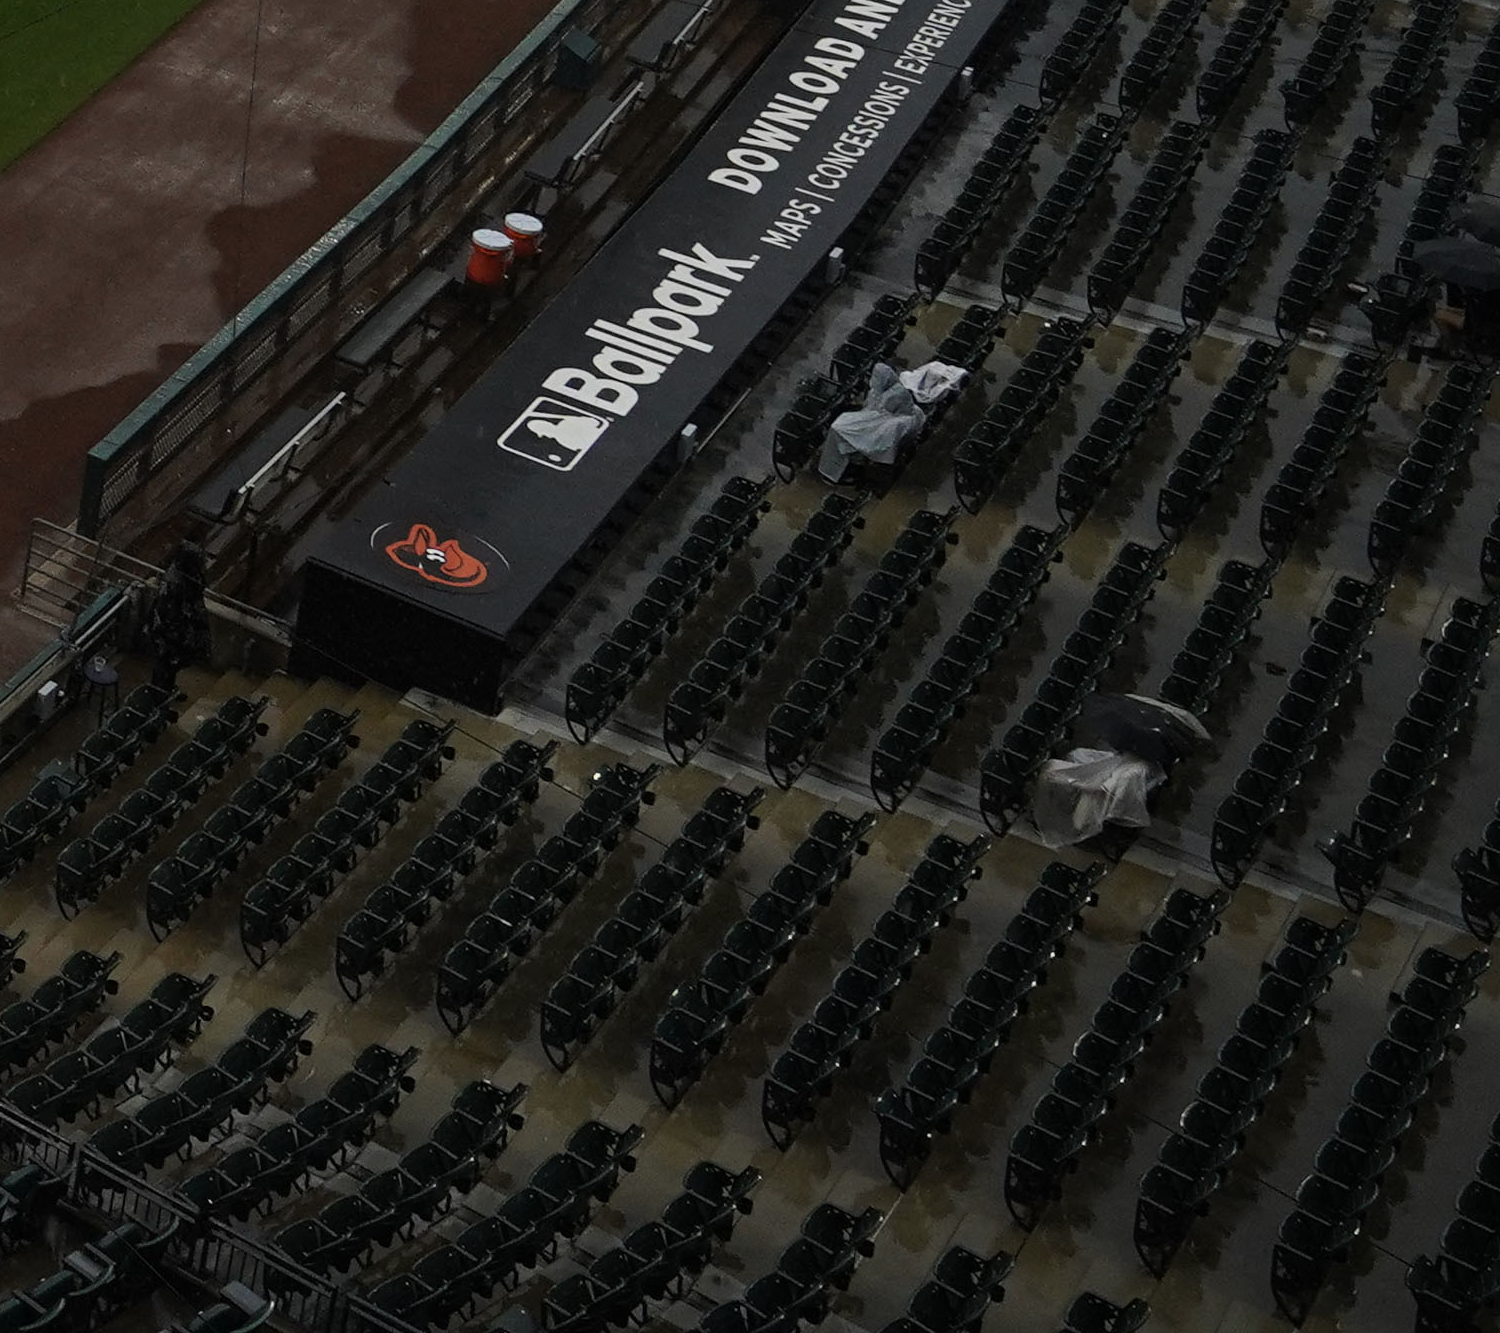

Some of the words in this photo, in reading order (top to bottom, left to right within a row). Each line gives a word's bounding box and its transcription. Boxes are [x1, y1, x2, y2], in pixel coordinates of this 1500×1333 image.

[707, 35, 866, 195] DOWNLOAD
[760, 186, 822, 250] MAPS
[807, 71, 911, 188] CONCESSIONS
